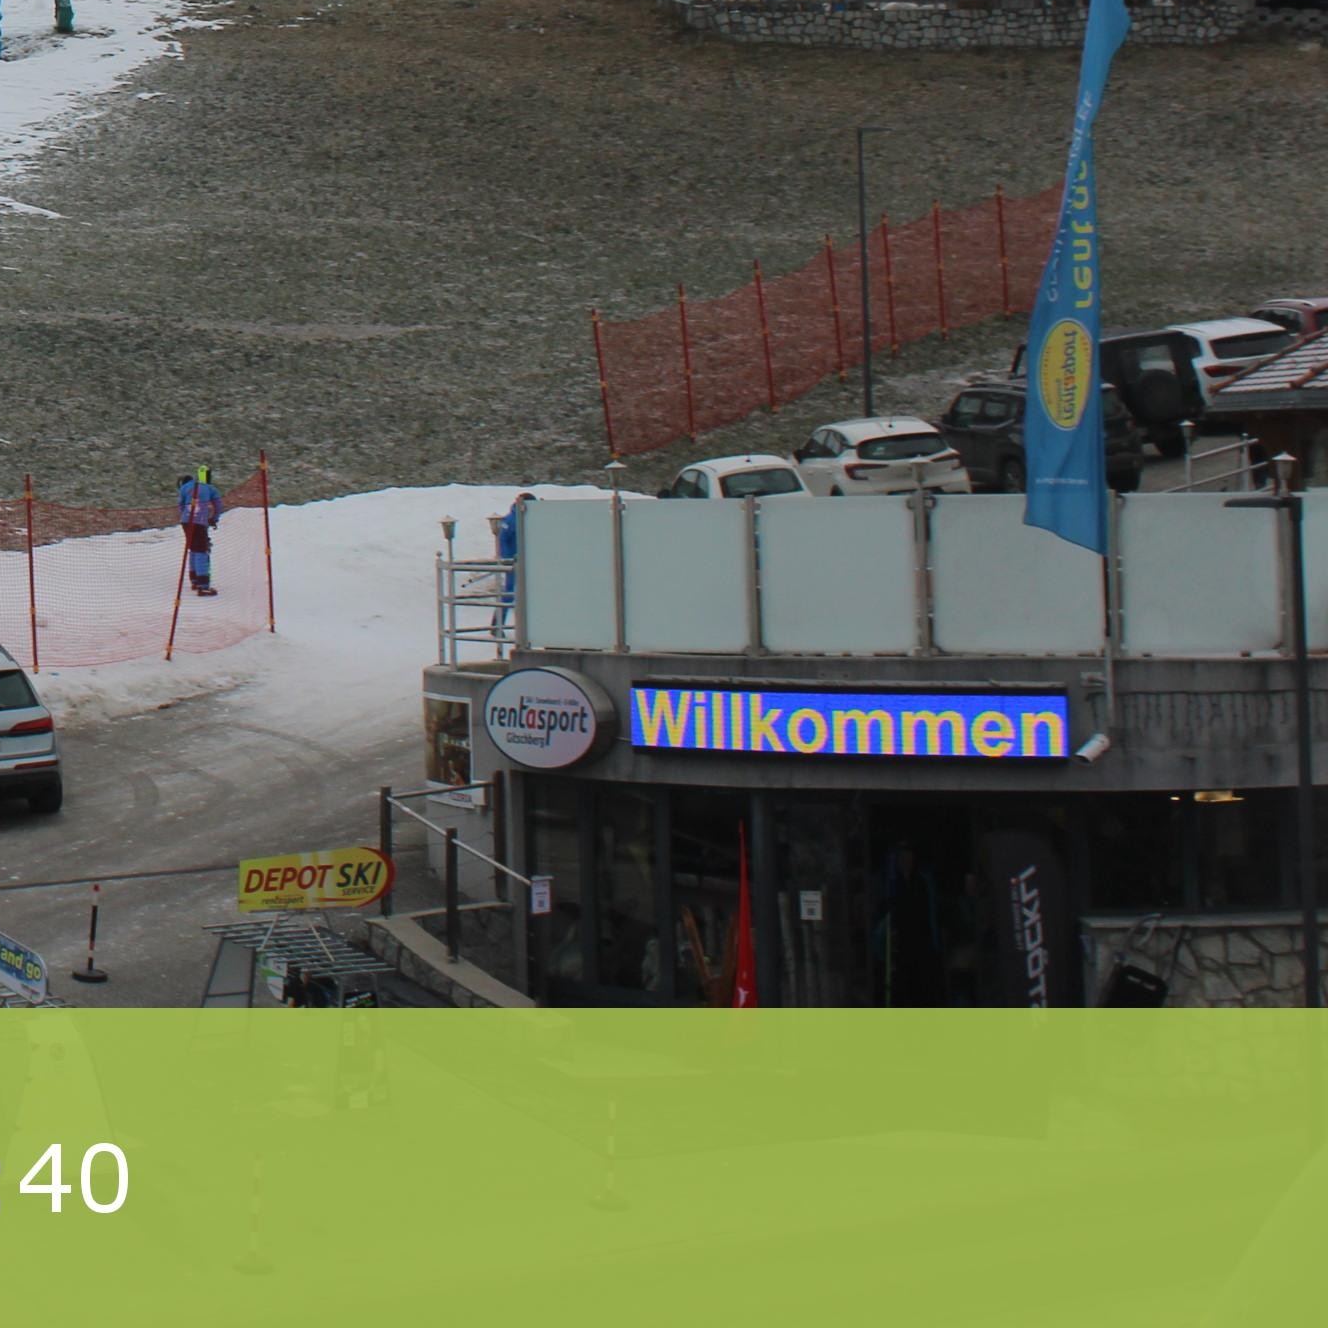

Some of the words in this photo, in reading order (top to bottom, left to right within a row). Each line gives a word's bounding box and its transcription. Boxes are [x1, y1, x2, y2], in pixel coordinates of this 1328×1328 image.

[489, 695, 589, 747] rentasport
[637, 690, 1064, 757] Willkommen
[243, 864, 334, 894] DEPOT
[336, 860, 383, 888] SKI
[0, 947, 24, 970] and
[25, 961, 42, 980] go
